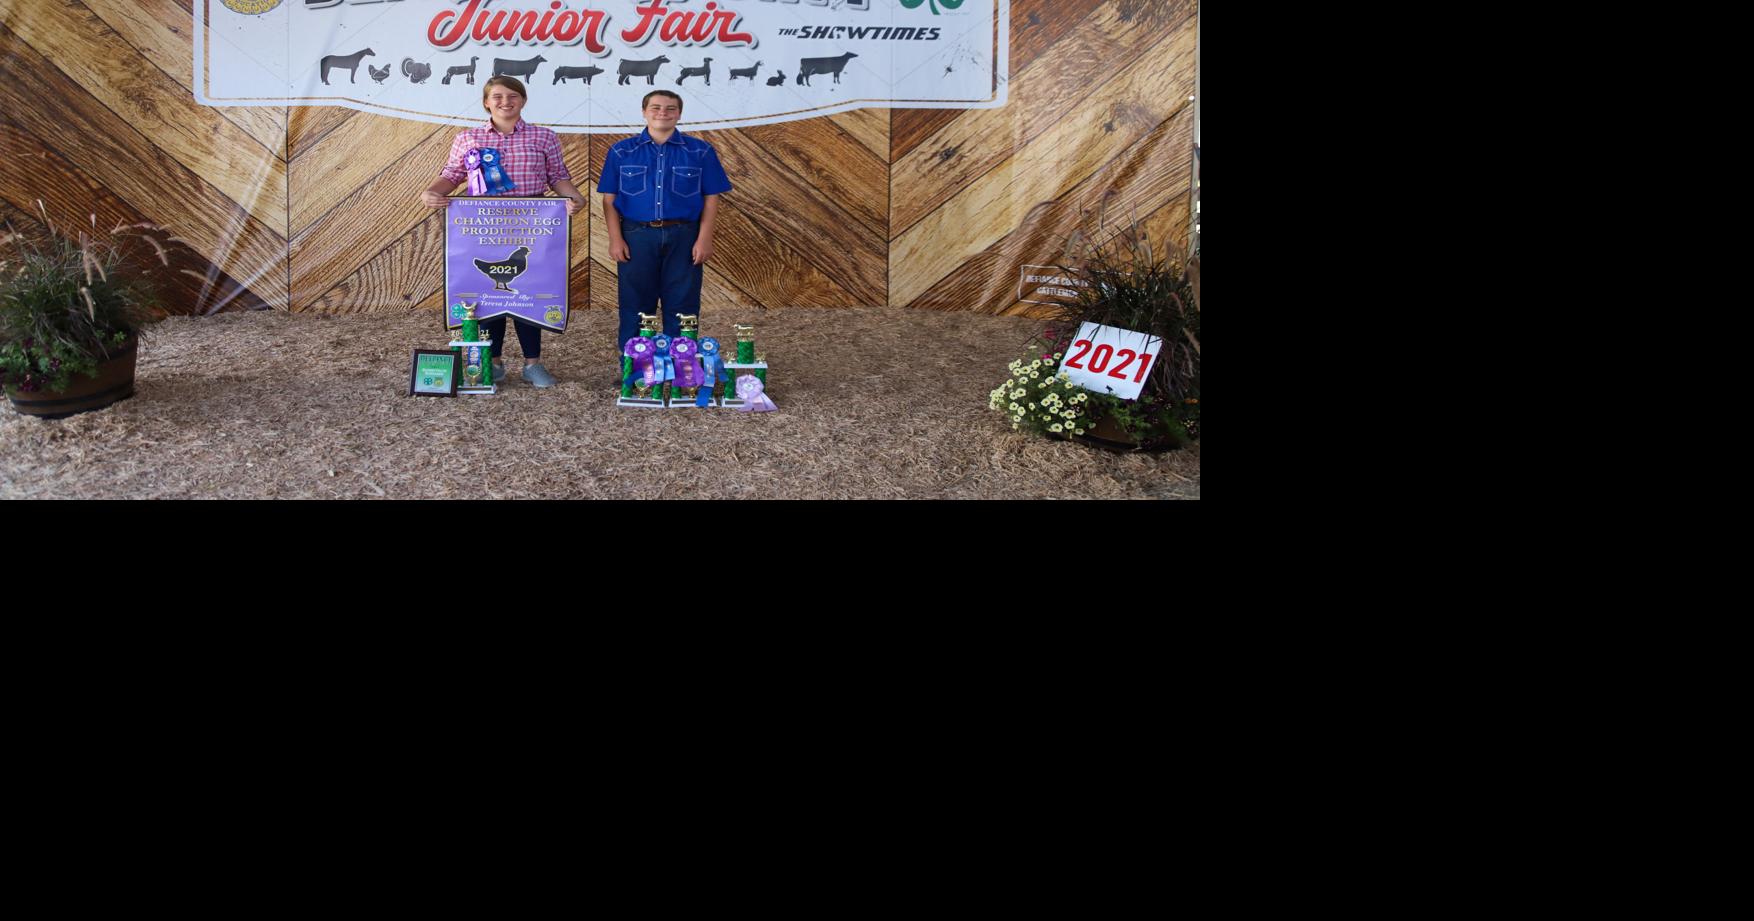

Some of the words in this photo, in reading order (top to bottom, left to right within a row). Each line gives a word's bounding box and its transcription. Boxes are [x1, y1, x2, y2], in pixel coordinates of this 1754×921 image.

[427, 0, 607, 54] Junior
[621, 0, 753, 44] Fair
[778, 28, 798, 36] THE
[478, 207, 539, 216] RESERVE
[454, 217, 529, 226] CHAMPION
[533, 217, 561, 226] EGG
[462, 227, 554, 236] PRODUCTION
[479, 237, 537, 245] EXHIBIT
[489, 265, 519, 274] 2021
[1064, 339, 1153, 384] 2021
